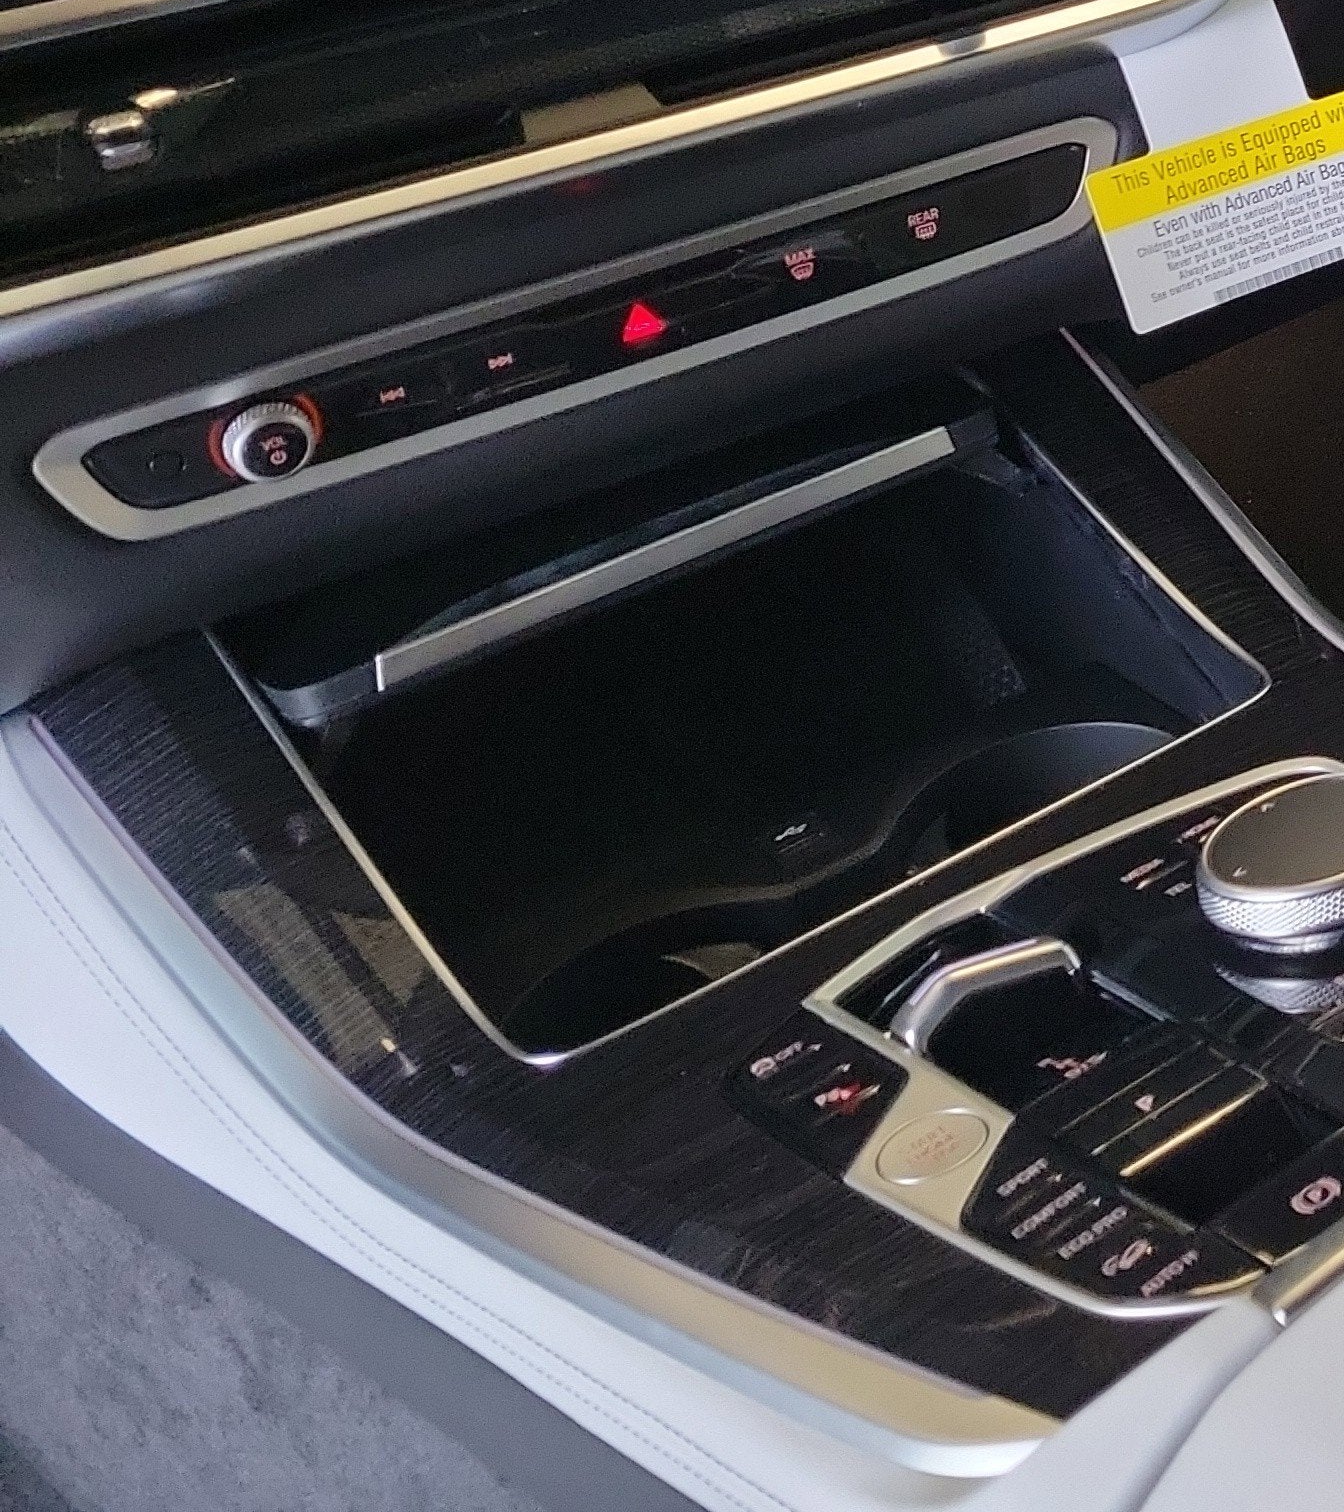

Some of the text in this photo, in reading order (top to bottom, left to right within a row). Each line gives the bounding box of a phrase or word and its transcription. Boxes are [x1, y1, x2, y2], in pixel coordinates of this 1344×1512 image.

[1111, 169, 1150, 194] This
[1151, 147, 1217, 180] Vehicle
[1219, 140, 1237, 159] is
[1239, 109, 1321, 152] Equipped
[1166, 138, 1326, 205] Advanced Air Bags
[907, 207, 940, 228] REAR
[1136, 239, 1173, 258] Children
[1174, 232, 1191, 245] can
[1191, 228, 1204, 238] be
[1204, 217, 1230, 233] killed
[1231, 215, 1241, 225] or
[1243, 199, 1283, 221] seriously
[1285, 187, 1317, 206] injured
[1318, 184, 1330, 196] by
[1152, 215, 1189, 238] Even
[1189, 201, 1222, 224] with
[1225, 175, 1293, 214] Advanced
[1296, 169, 1315, 189] Air
[1162, 248, 1182, 260] The
[1182, 240, 1203, 254] back
[1204, 232, 1224, 246] seat
[1225, 229, 1235, 239] is
[1234, 223, 1251, 235] the
[1251, 212, 1280, 230] safest
[1280, 205, 1305, 220] place
[1305, 199, 1319, 211] for
[784, 247, 816, 267] MAX
[1150, 290, 1168, 303] See
[1168, 277, 1203, 296] owner's
[1203, 263, 1237, 283] manual
[1236, 259, 1251, 271] for
[1252, 251, 1277, 265] more
[1277, 232, 1329, 256] information
[1178, 262, 1209, 280] Always
[1210, 256, 1227, 269] use
[1228, 248, 1248, 262] seat
[1248, 240, 1271, 255] belts
[1272, 232, 1290, 246] and
[1291, 223, 1314, 240] child
[996, 1157, 1049, 1197] SPORT
[1010, 1180, 1087, 1239] COMFORT
